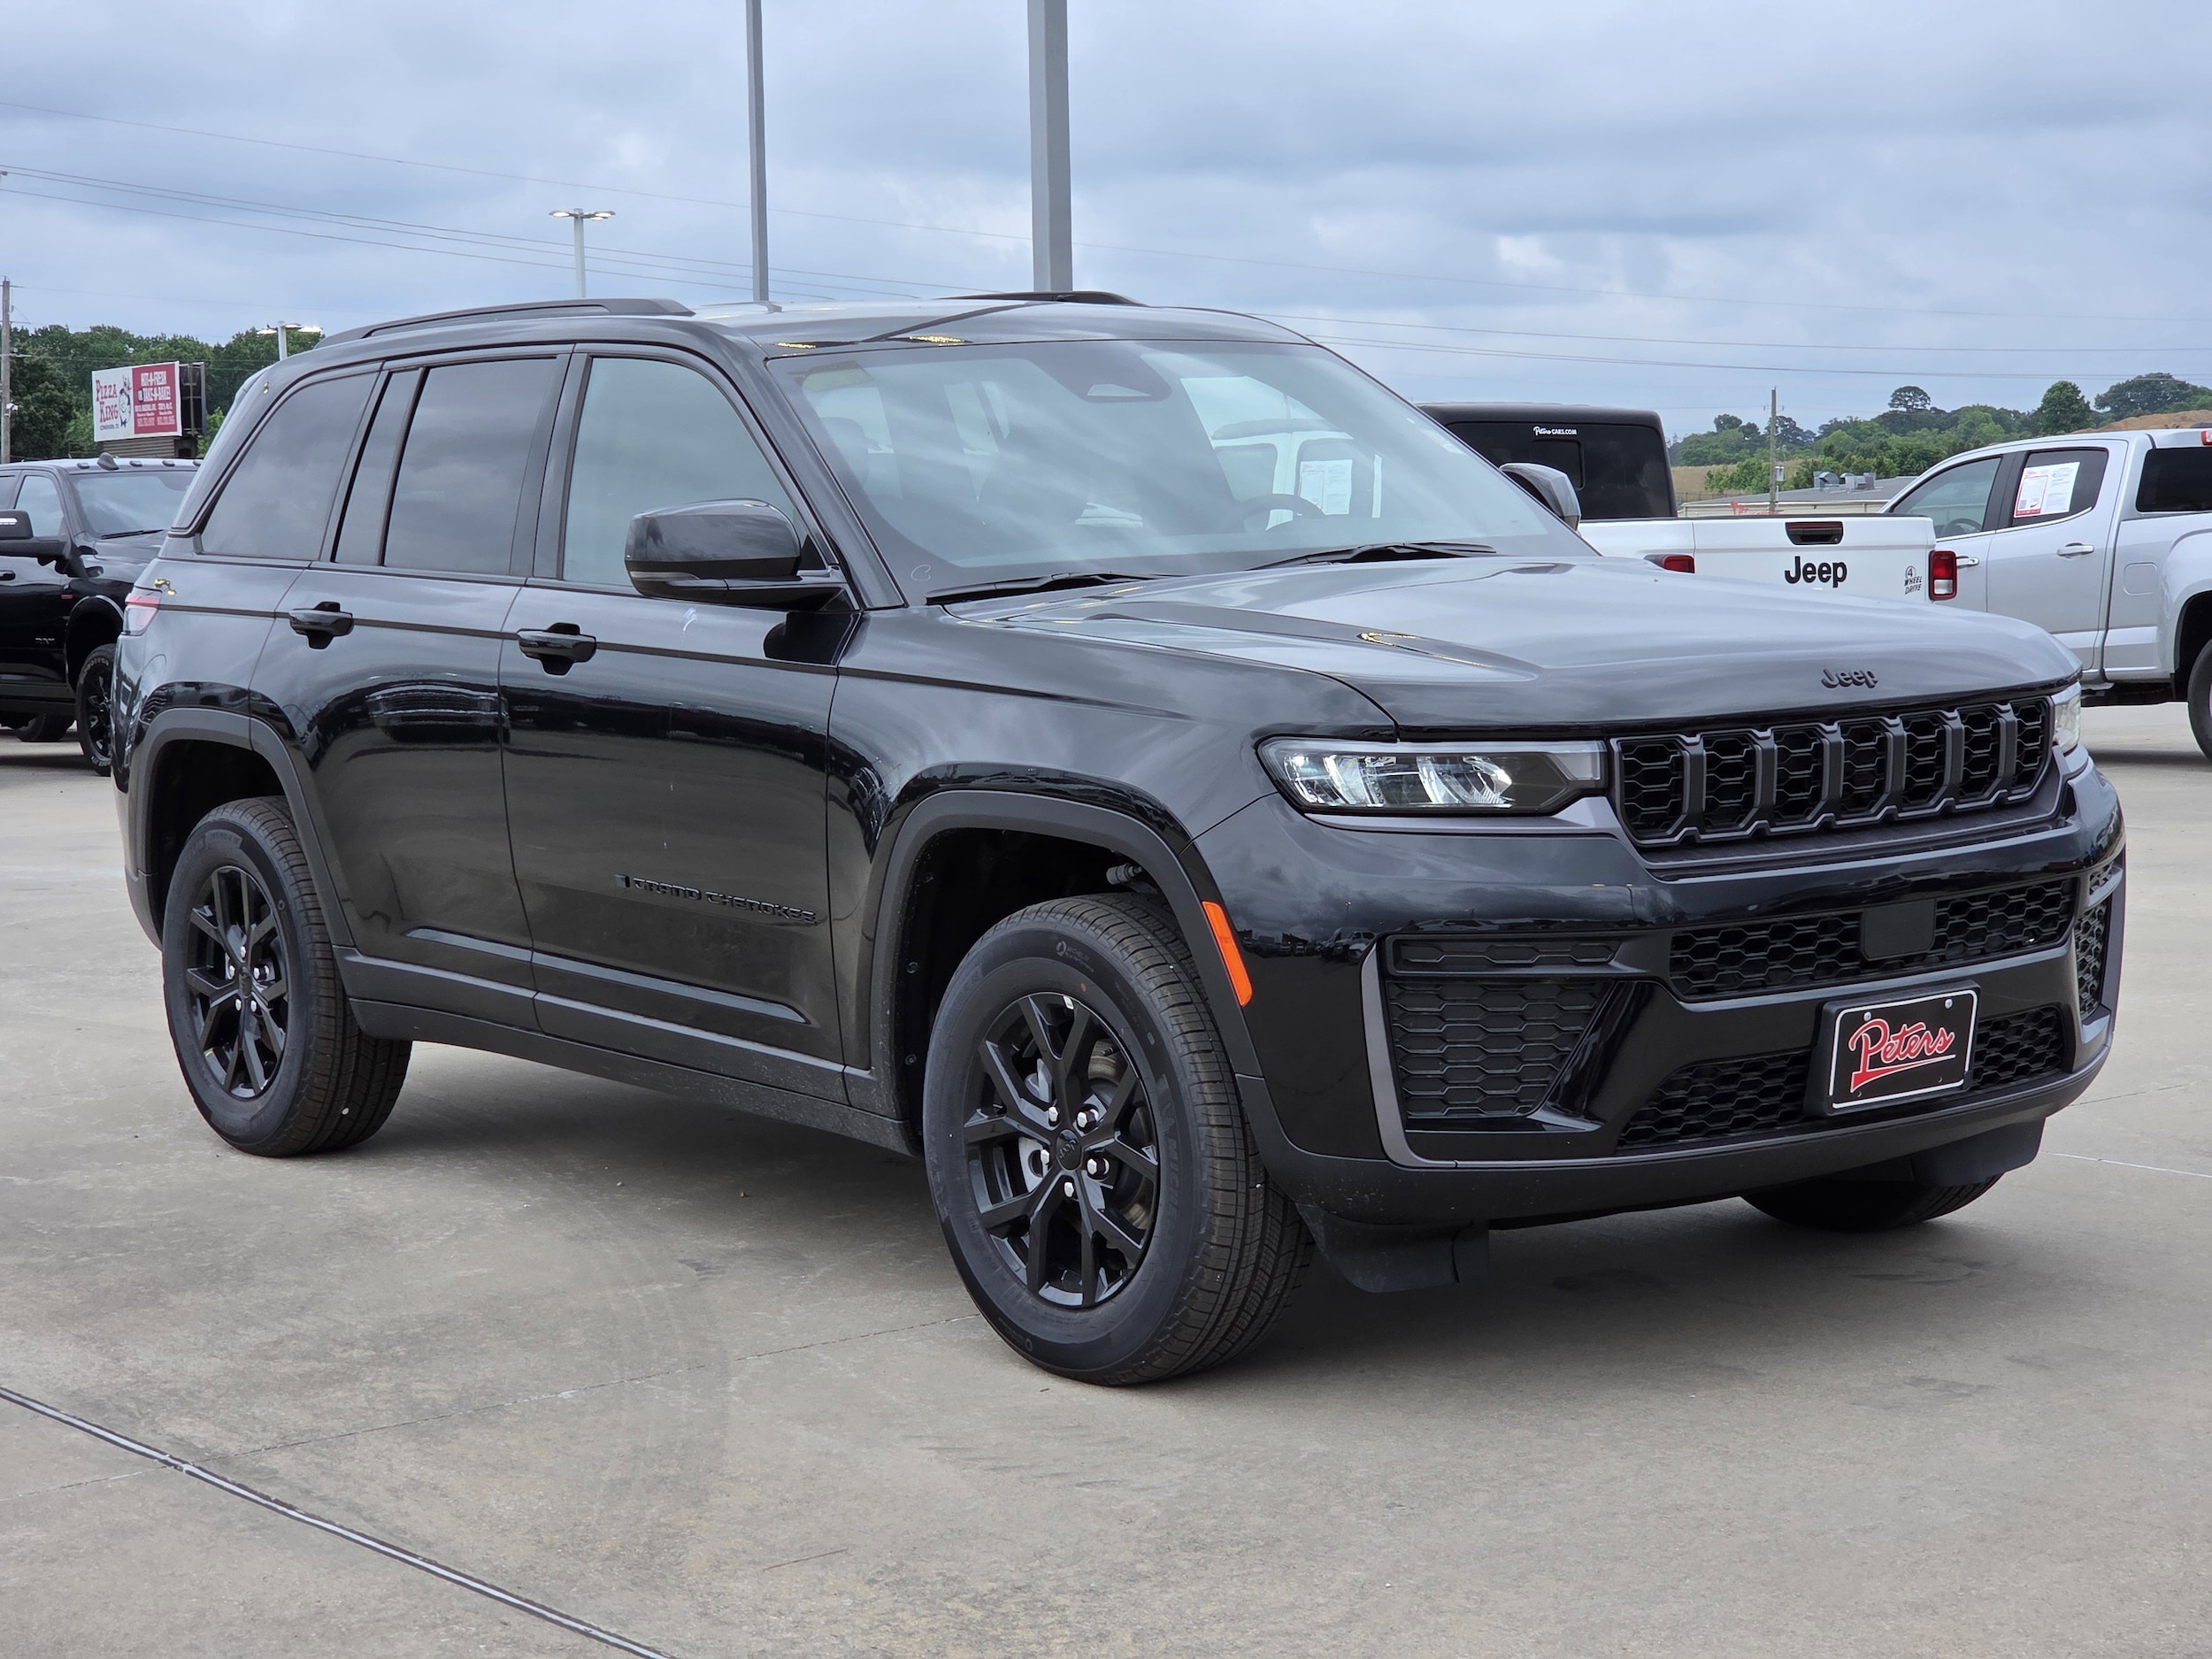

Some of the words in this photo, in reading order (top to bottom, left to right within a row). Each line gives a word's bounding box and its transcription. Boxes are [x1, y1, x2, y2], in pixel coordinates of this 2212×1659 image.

[96, 380, 119, 402] PIZZA
[99, 401, 119, 423] KING
[1784, 556, 1847, 588] Jeep
[1904, 576, 1923, 587] WHEEL
[1904, 583, 1923, 595] DRIVE
[1820, 668, 1879, 689] Jeep
[632, 877, 703, 901] GRAND
[704, 890, 817, 925] CHEROKEE
[1847, 1018, 1955, 1074] Peters
